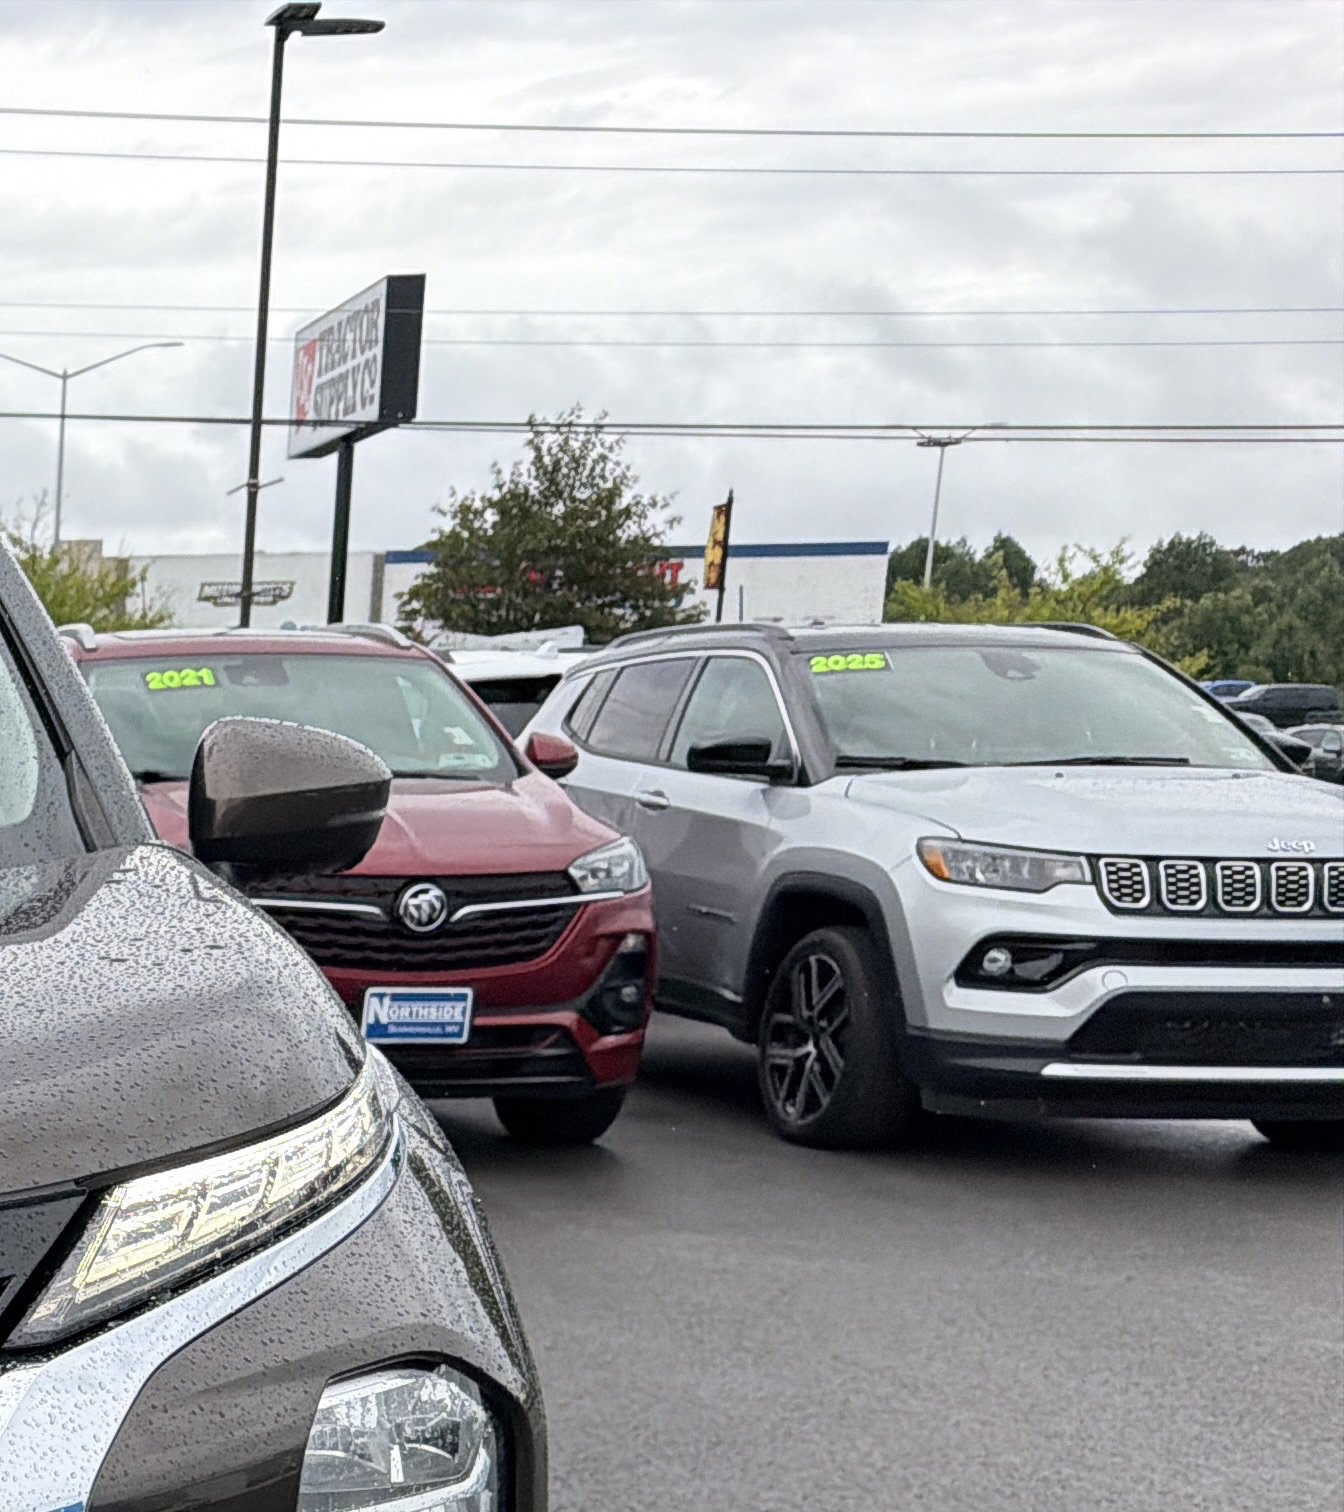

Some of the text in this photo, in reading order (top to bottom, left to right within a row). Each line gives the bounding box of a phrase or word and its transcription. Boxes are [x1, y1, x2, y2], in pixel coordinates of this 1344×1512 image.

[809, 653, 886, 673] 2025
[145, 667, 216, 690] 2021
[1266, 837, 1316, 854] Jeep
[367, 996, 465, 1024] NORTHSIDE
